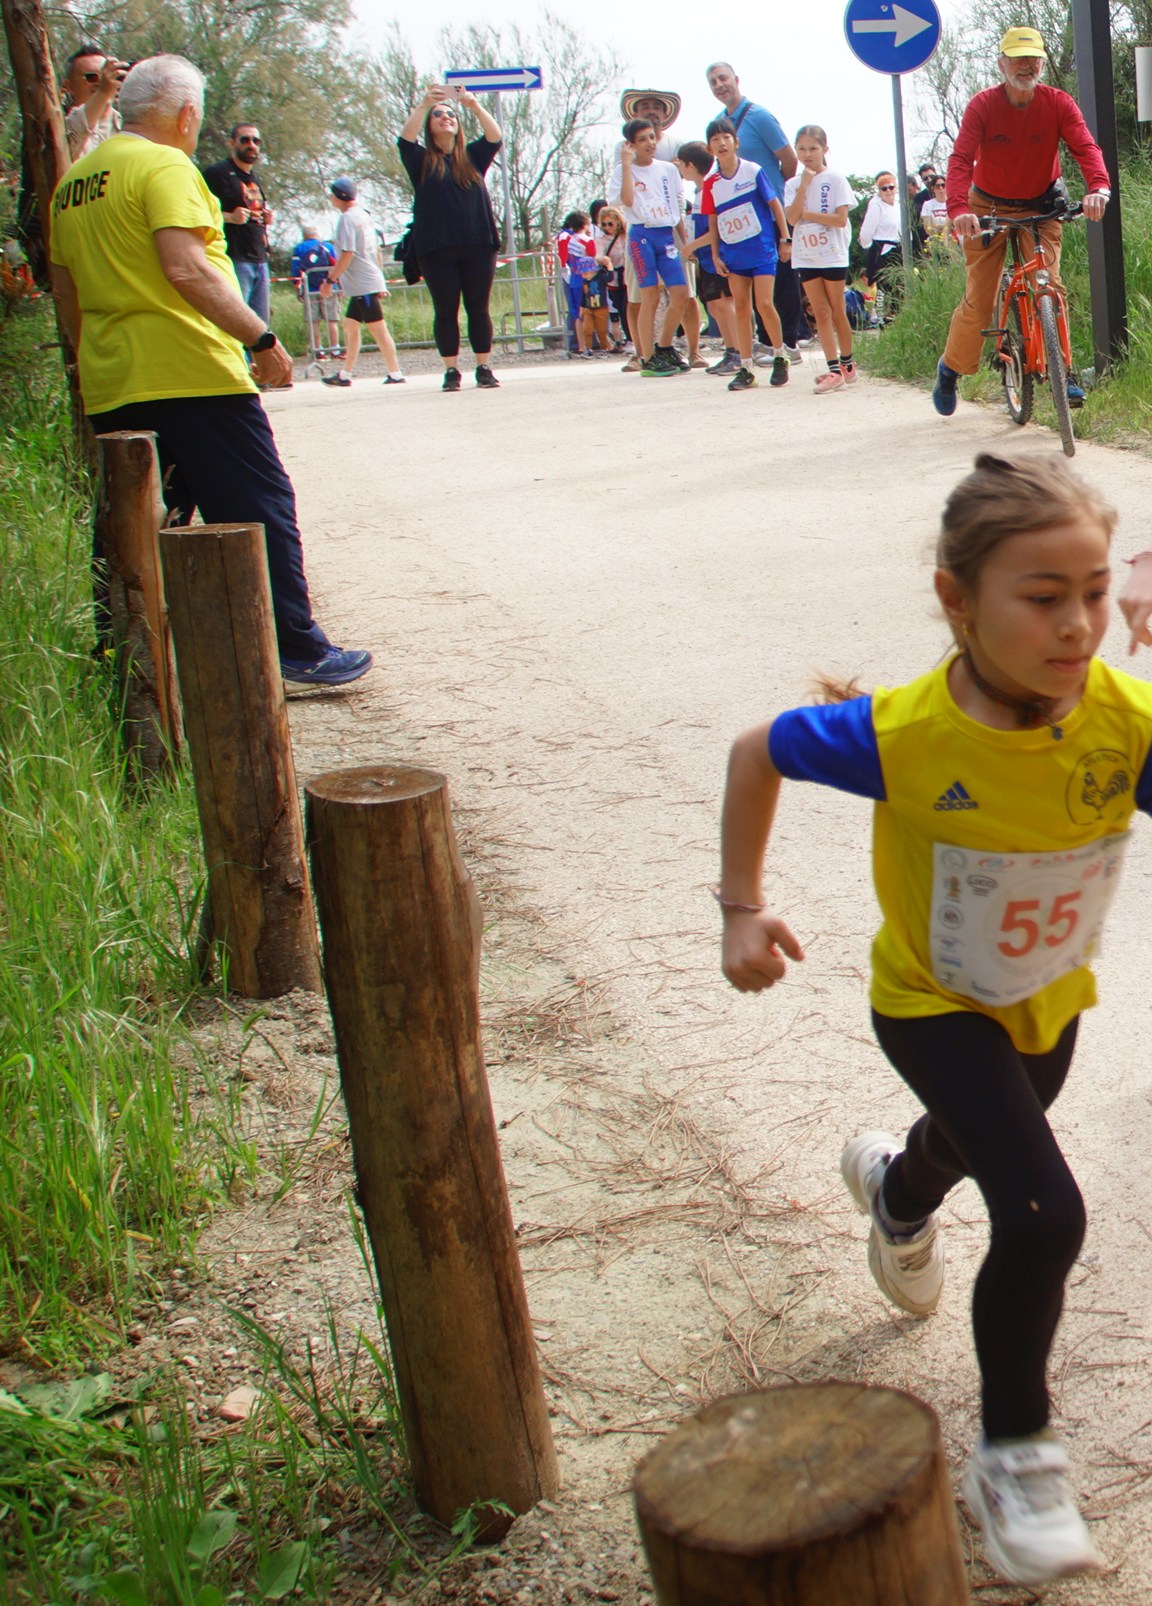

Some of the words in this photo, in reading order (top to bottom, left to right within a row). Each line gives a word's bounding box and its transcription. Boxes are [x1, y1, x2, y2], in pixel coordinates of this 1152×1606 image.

[724, 214, 751, 235] 201
[801, 231, 828, 249] 105
[933, 799, 980, 812] adidas
[996, 890, 1084, 959] 55
